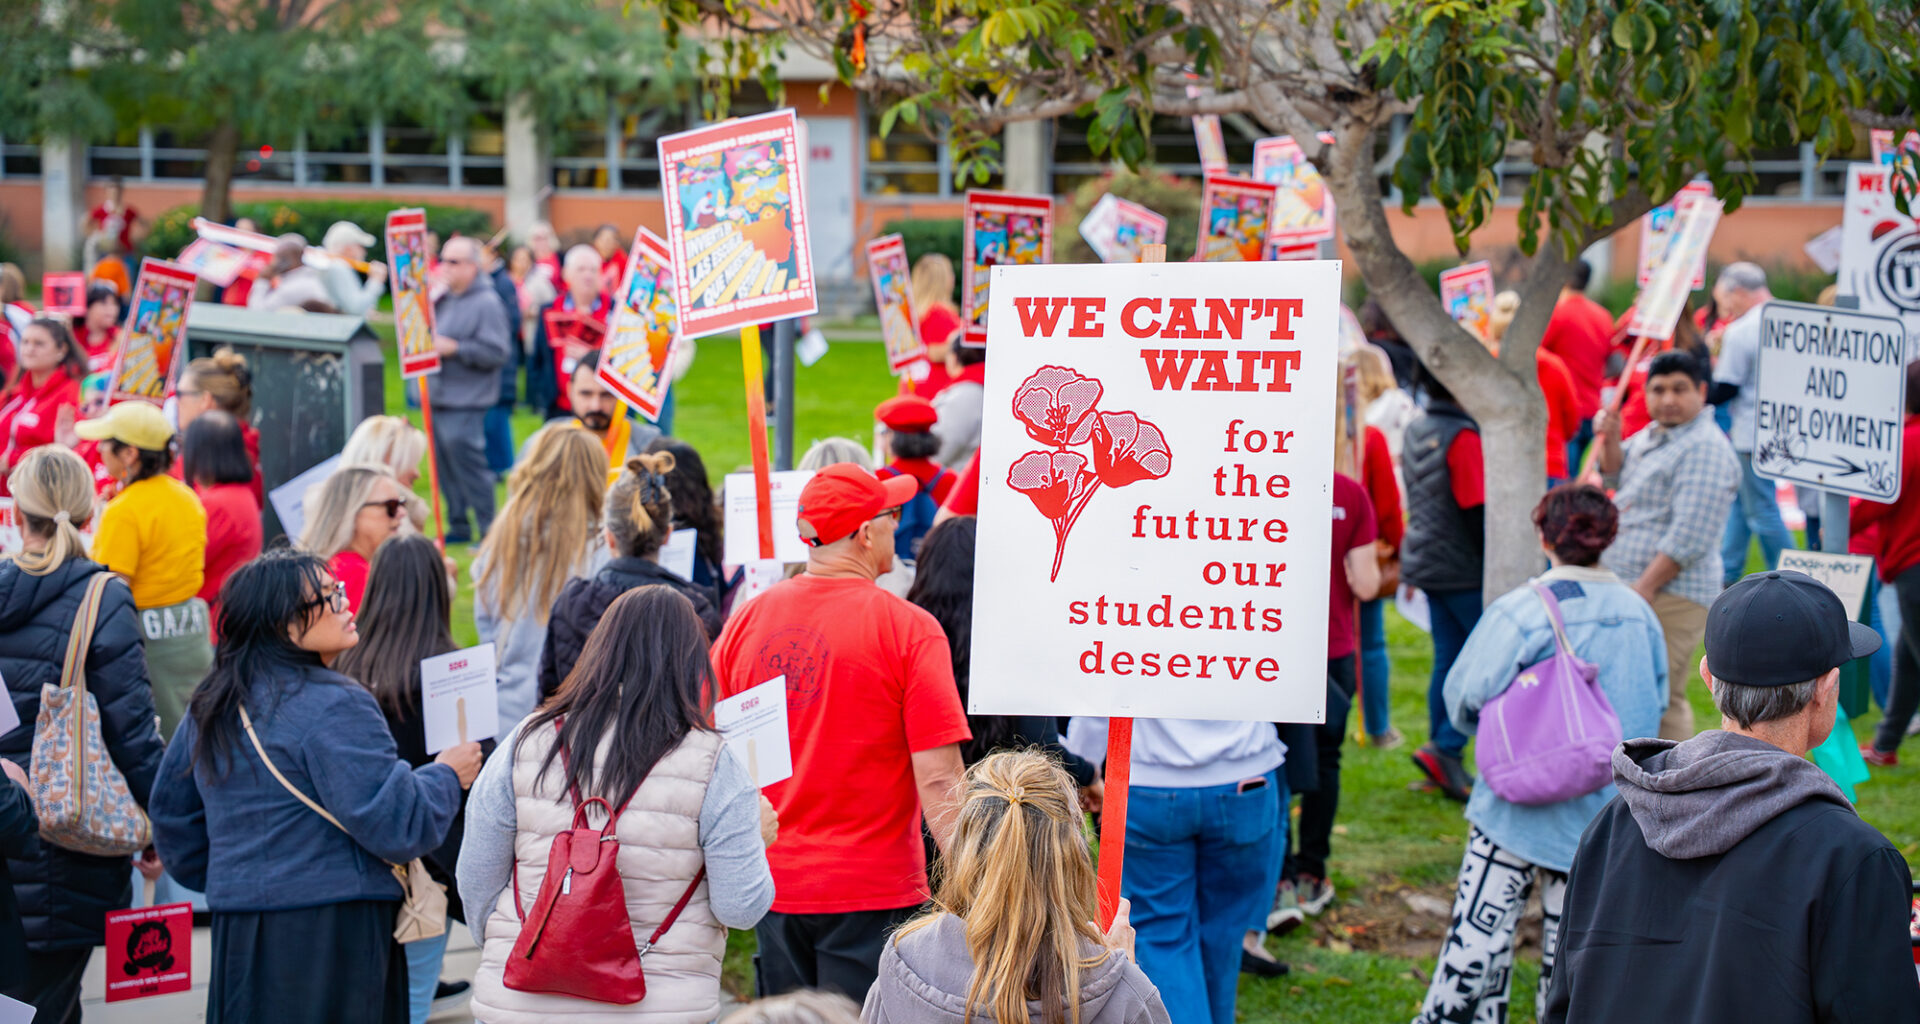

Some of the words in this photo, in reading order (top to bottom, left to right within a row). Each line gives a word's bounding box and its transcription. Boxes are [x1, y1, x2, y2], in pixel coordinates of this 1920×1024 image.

[1858, 173, 1884, 192] WE
[1013, 297, 1106, 338] WE
[1120, 298, 1303, 341] CAN’T
[1762, 318, 1901, 366] INFORMATION
[1140, 349, 1302, 393] WAIT
[1805, 365, 1848, 400] AND
[1223, 419, 1295, 454] for
[1758, 400, 1898, 452] EMPLOYMENT
[1213, 464, 1291, 499] the
[1131, 505, 1289, 543] future
[1202, 561, 1287, 588] our
[143, 605, 205, 640] GAZA
[1068, 594, 1283, 632] students
[1079, 641, 1280, 682] deserve
